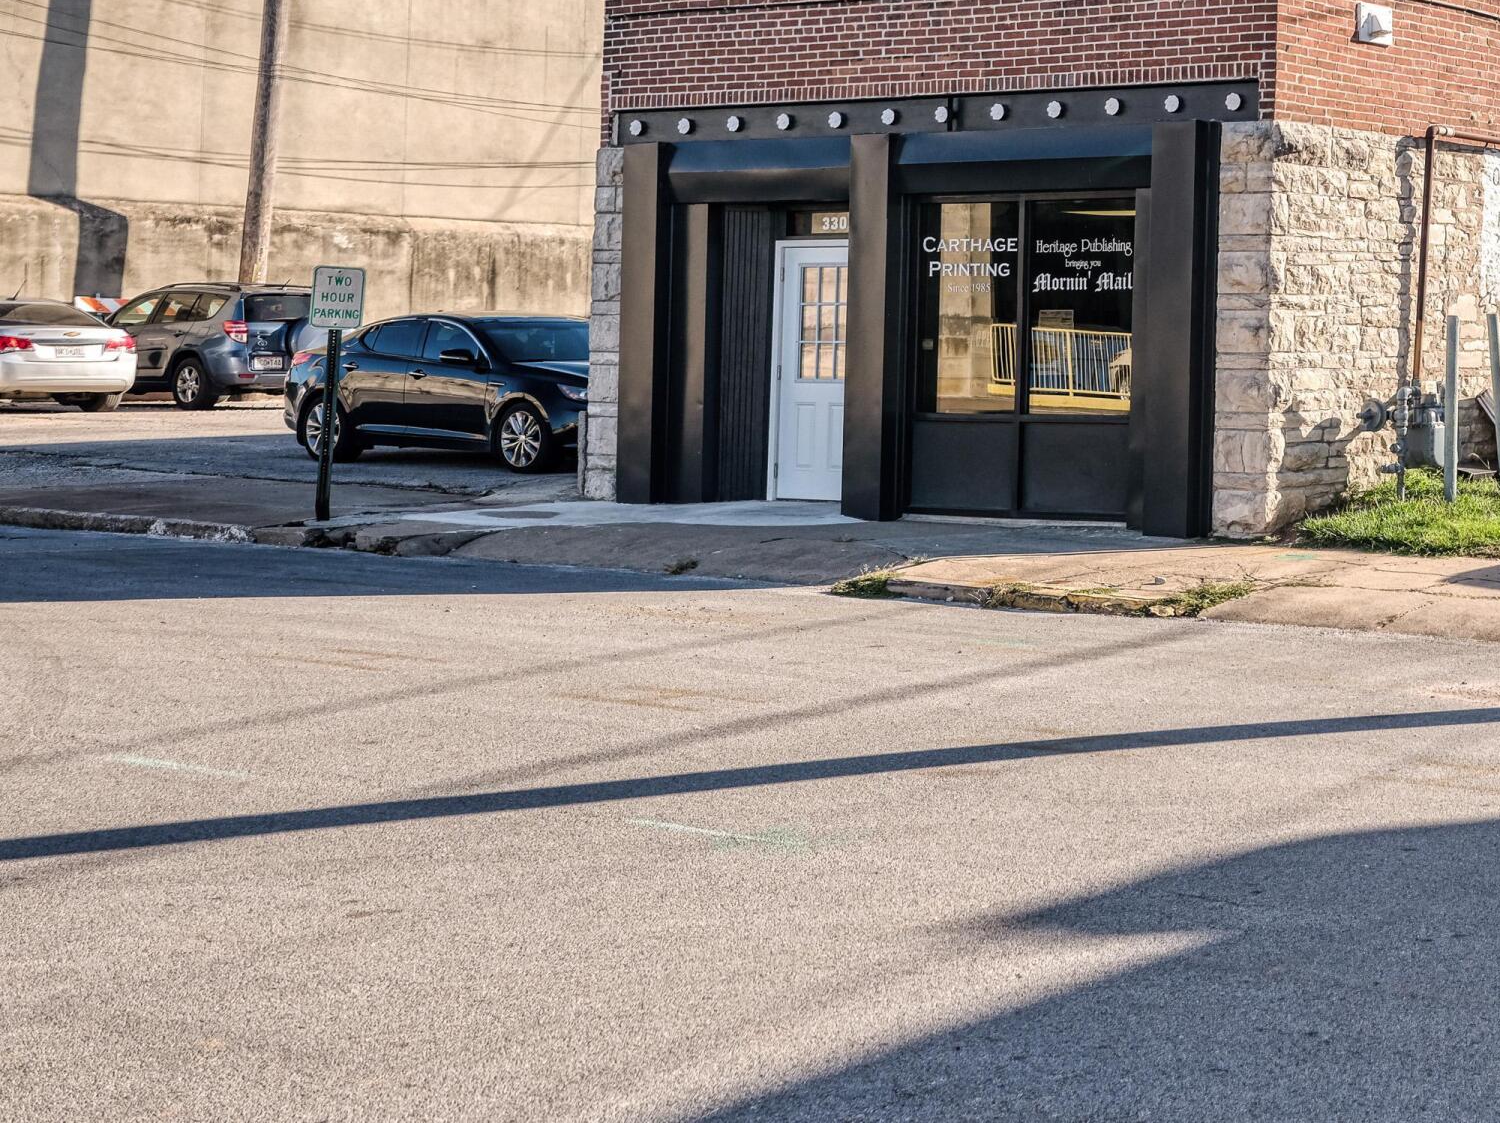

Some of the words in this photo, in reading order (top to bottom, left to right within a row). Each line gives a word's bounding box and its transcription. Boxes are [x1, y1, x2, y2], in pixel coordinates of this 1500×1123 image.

[822, 216, 848, 231] 330
[922, 236, 1018, 253] CARTHAGE
[1036, 239, 1078, 257] Heritage
[1081, 237, 1133, 257] Publishing
[928, 260, 1011, 277] PRINTING
[1065, 258, 1089, 270] bringing
[1089, 260, 1102, 270] you
[327, 275, 352, 287] TWO
[947, 282, 969, 293] Since
[971, 282, 992, 293] 1985
[1032, 270, 1092, 293] Mornin'
[1094, 271, 1134, 293] Mail
[320, 292, 355, 303] HOUR
[313, 307, 360, 320] PARKING
